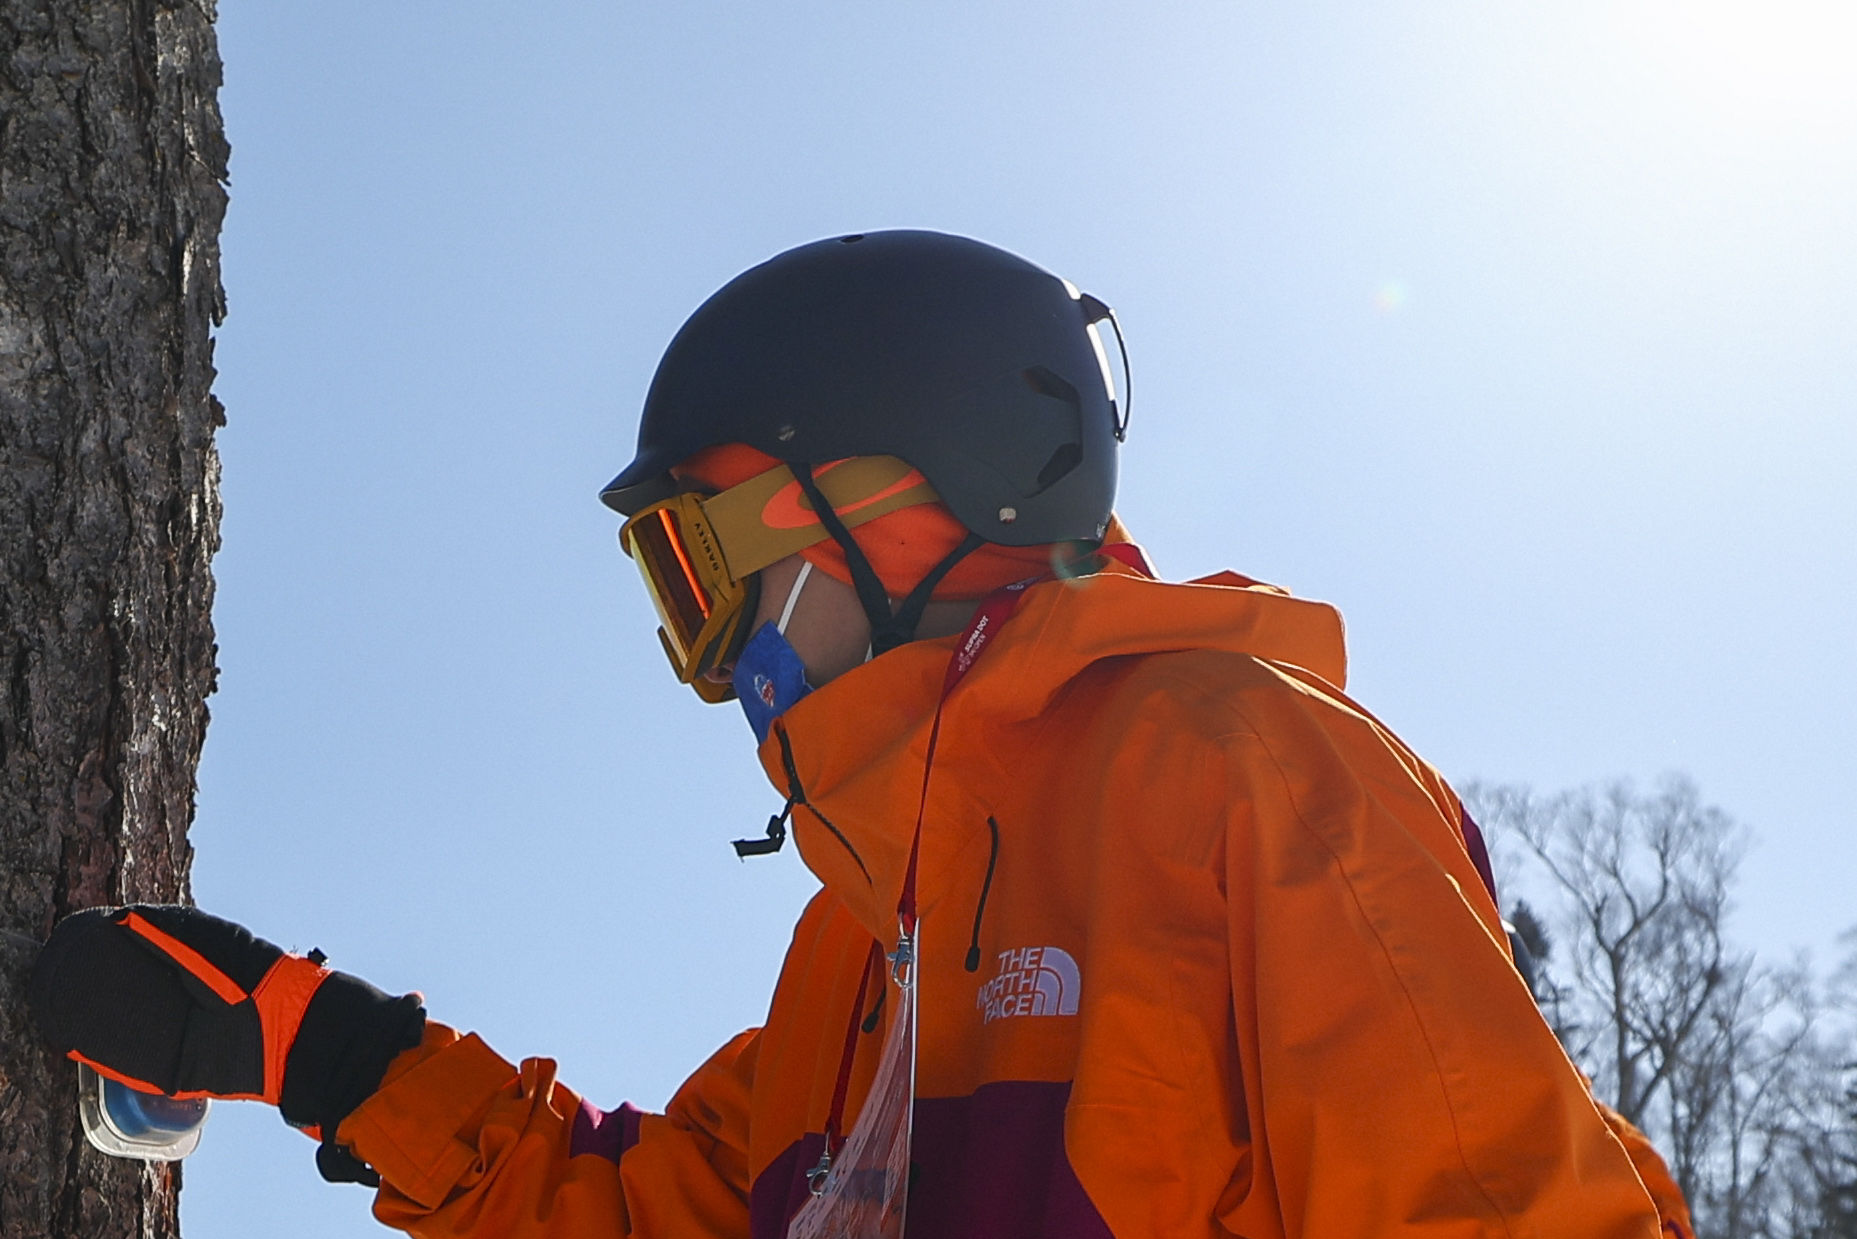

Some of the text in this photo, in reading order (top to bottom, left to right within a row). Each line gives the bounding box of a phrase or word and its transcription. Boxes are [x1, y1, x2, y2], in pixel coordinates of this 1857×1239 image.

[977, 615, 989, 632] DOT
[998, 947, 1042, 974] THE
[976, 969, 1038, 1010] NORTH
[984, 993, 1033, 1025] FACE
